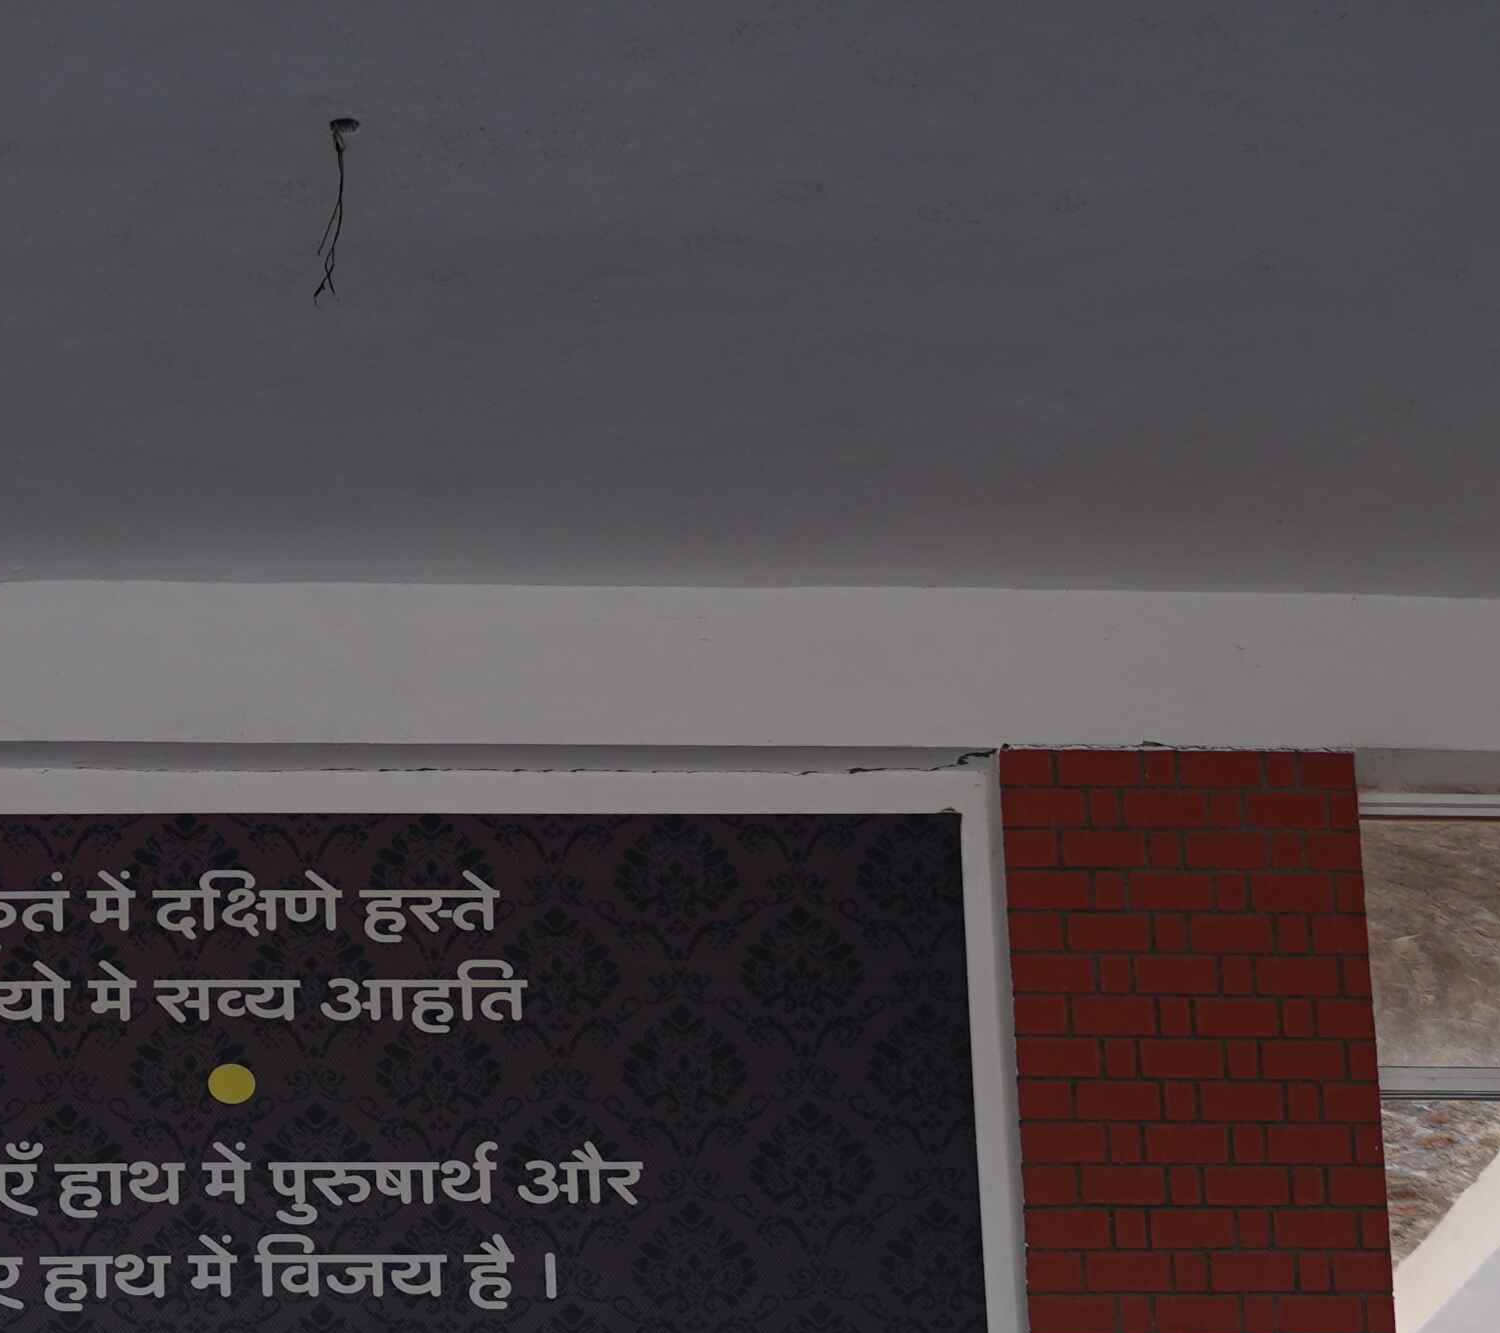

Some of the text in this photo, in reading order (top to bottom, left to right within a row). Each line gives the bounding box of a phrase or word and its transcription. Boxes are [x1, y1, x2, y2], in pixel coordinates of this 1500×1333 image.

[86, 870, 137, 932] में
[151, 869, 343, 940] दक्षिणे
[358, 869, 501, 943] हस्ते
[87, 959, 138, 1022] मे
[153, 979, 302, 1024] सव्य
[320, 959, 529, 1034] आहति
[53, 1160, 186, 1219] हाथ
[201, 1141, 252, 1205] में
[267, 1140, 499, 1226] पुरुषार्थ
[517, 1140, 644, 1206] और
[39, 1253, 172, 1312] हाथ
[187, 1234, 238, 1298] में
[253, 1233, 448, 1298] विजय
[463, 1233, 515, 1310] है
